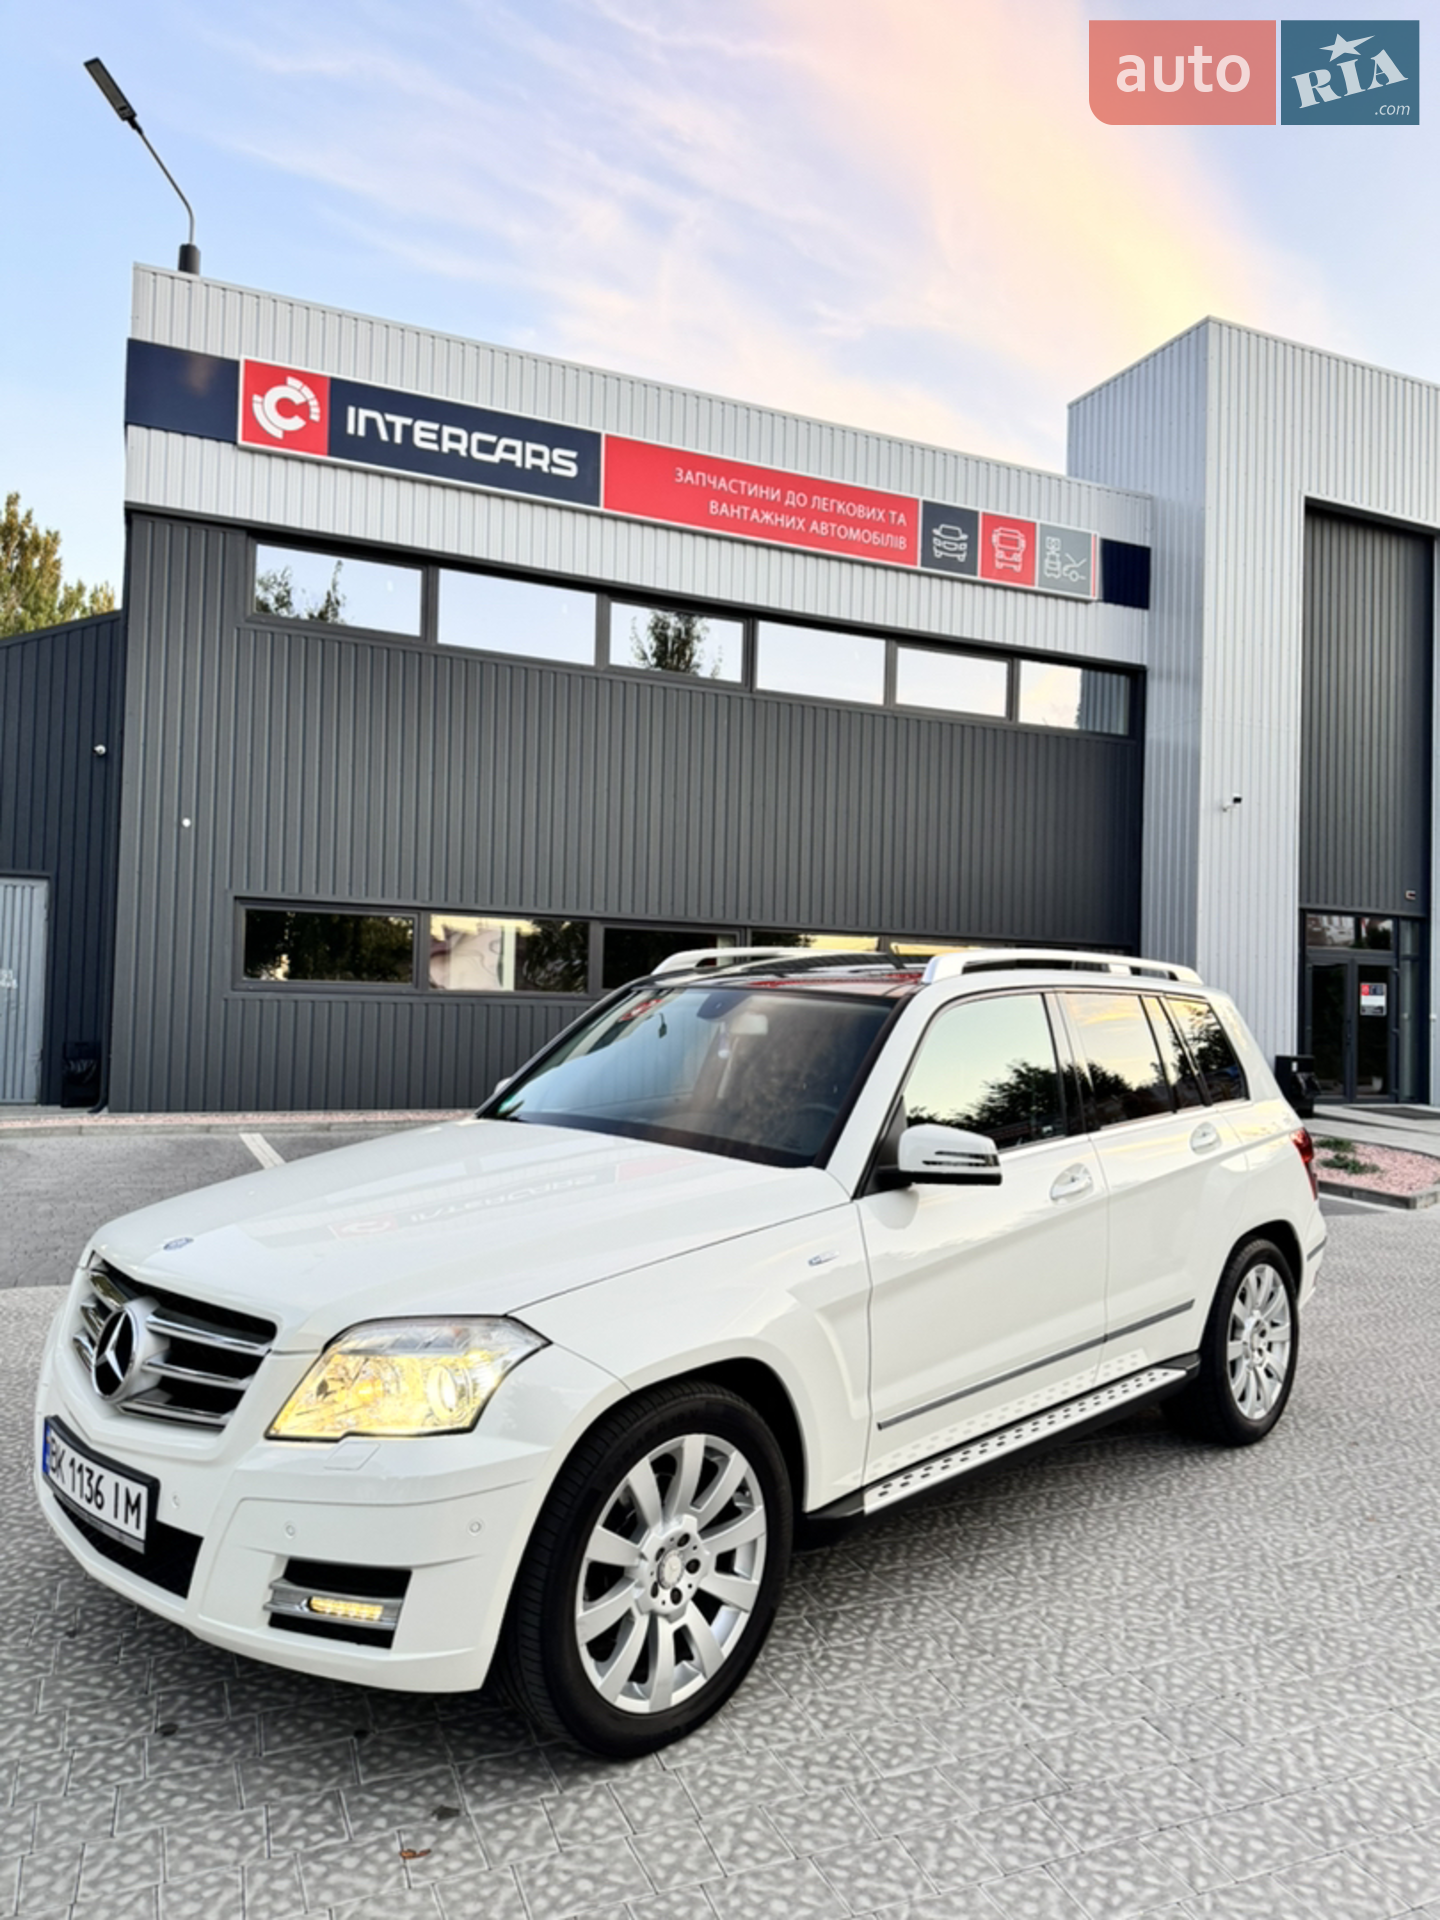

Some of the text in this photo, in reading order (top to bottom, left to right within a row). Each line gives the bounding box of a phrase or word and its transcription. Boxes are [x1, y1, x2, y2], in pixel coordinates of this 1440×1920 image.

[346, 405, 579, 478] INTERCARS
[674, 466, 908, 527] ЗАПЧАСТИНИ ДО ЛЕГКОВИХ ТА
[708, 499, 908, 551] ВАНТАЖНИХ АВТОМОБІЛІВ
[69, 1457, 104, 1510] 1136
[114, 1481, 141, 1530] IM
